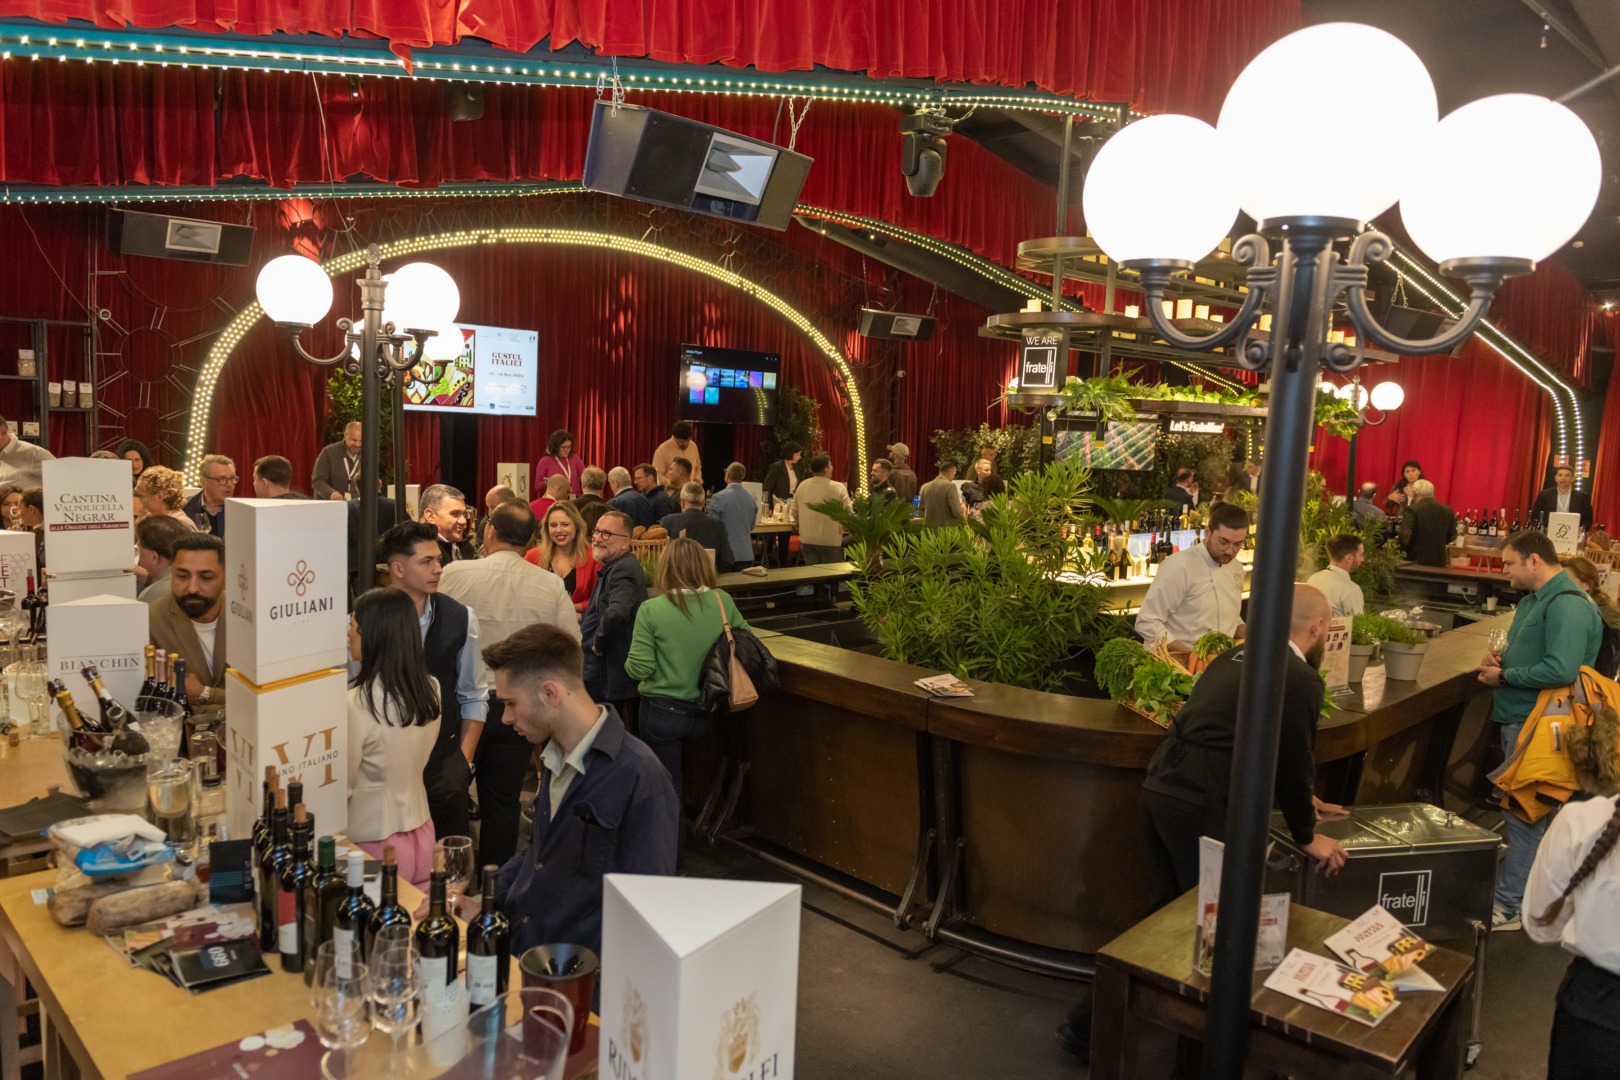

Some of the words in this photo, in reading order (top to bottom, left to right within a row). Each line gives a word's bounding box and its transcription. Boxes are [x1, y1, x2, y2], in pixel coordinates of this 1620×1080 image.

[1026, 336, 1040, 346] WE
[1041, 335, 1058, 345] ARE
[1025, 349, 1054, 385] fratelli
[1169, 420, 1189, 432] Let's
[59, 493, 118, 504] CANTINA
[54, 503, 124, 513] VALPOLICELLA
[63, 512, 115, 523] NEGRAR
[269, 596, 334, 621] GIULIANI
[298, 749, 340, 771] ITALIANO
[1382, 874, 1426, 922] fratelli
